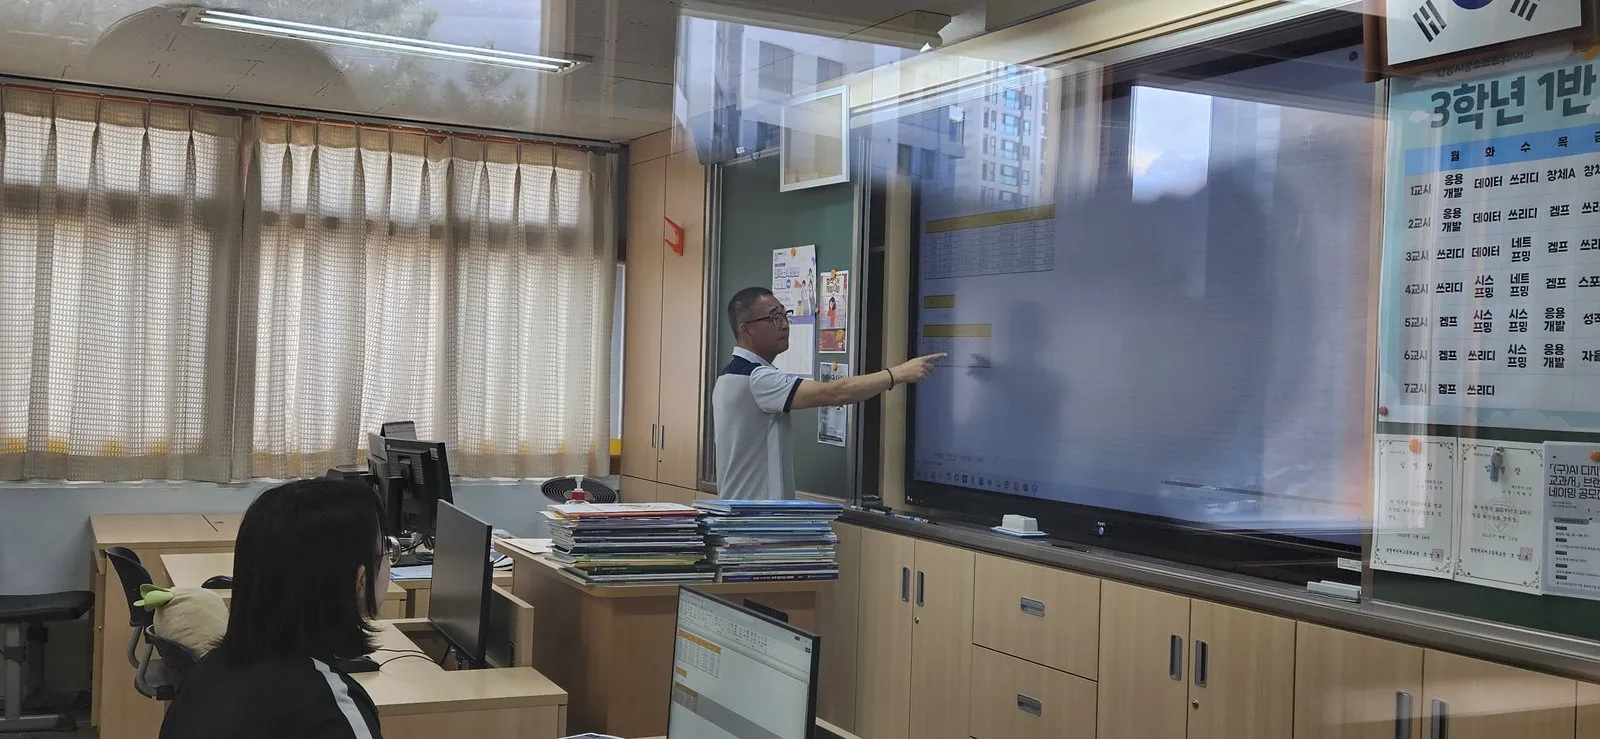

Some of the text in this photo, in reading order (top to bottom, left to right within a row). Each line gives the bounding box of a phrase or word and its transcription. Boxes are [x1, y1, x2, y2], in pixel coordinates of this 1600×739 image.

[1431, 64, 1596, 129] 3학년 1반
[1451, 151, 1460, 162] 월
[1485, 147, 1495, 157] 화
[1521, 142, 1530, 153] 수
[1557, 137, 1568, 147] 목
[1444, 174, 1463, 185] 응용
[1509, 172, 1539, 185] 쓰리디
[1547, 169, 1575, 181] 창체A
[1475, 176, 1503, 188] 데이터
[1410, 184, 1431, 196] 1교시
[1444, 187, 1463, 199] 개발
[1442, 208, 1462, 219] 응용
[1508, 208, 1537, 220] 쓰리디
[1550, 205, 1570, 216] 겜프
[1473, 211, 1501, 223] 데이터
[1408, 218, 1431, 229] 2교시
[1442, 221, 1462, 232] 개발
[1512, 237, 1531, 248] 네트
[1548, 241, 1568, 253] 겜프
[1406, 252, 1429, 261] 3교시
[1437, 248, 1464, 260] 쓰리디
[1472, 246, 1500, 258] 데이터
[1512, 251, 1530, 262] 프밍
[1475, 275, 1494, 285] 시스
[1510, 273, 1530, 285] 네트
[1546, 277, 1566, 289] 겜프
[1405, 284, 1428, 294] 4교시
[1436, 282, 1463, 293] 쓰리디
[1475, 287, 1494, 298] 프밍
[1510, 286, 1529, 297] 프밍
[1474, 309, 1493, 321] 시스
[1509, 308, 1528, 320] 시스
[1545, 307, 1565, 319] 응용
[1405, 317, 1428, 327] 5교시
[1440, 316, 1458, 327] 겜프
[1509, 321, 1528, 332] 프밍
[1544, 320, 1565, 332] 개발
[1473, 322, 1492, 333] 프밍
[1404, 350, 1427, 360] 6교시
[1508, 344, 1527, 355] 시스
[1544, 344, 1564, 355] 응용
[1439, 350, 1457, 361] 겜프
[1468, 350, 1495, 361] 쓰리디
[1508, 357, 1527, 368] 프밍
[1543, 357, 1565, 368] 개발
[1404, 383, 1427, 394] 7교시
[1438, 384, 1457, 395] 겜프
[1467, 384, 1495, 396] 쓰리디
[1549, 487, 1576, 498] 네이밍
